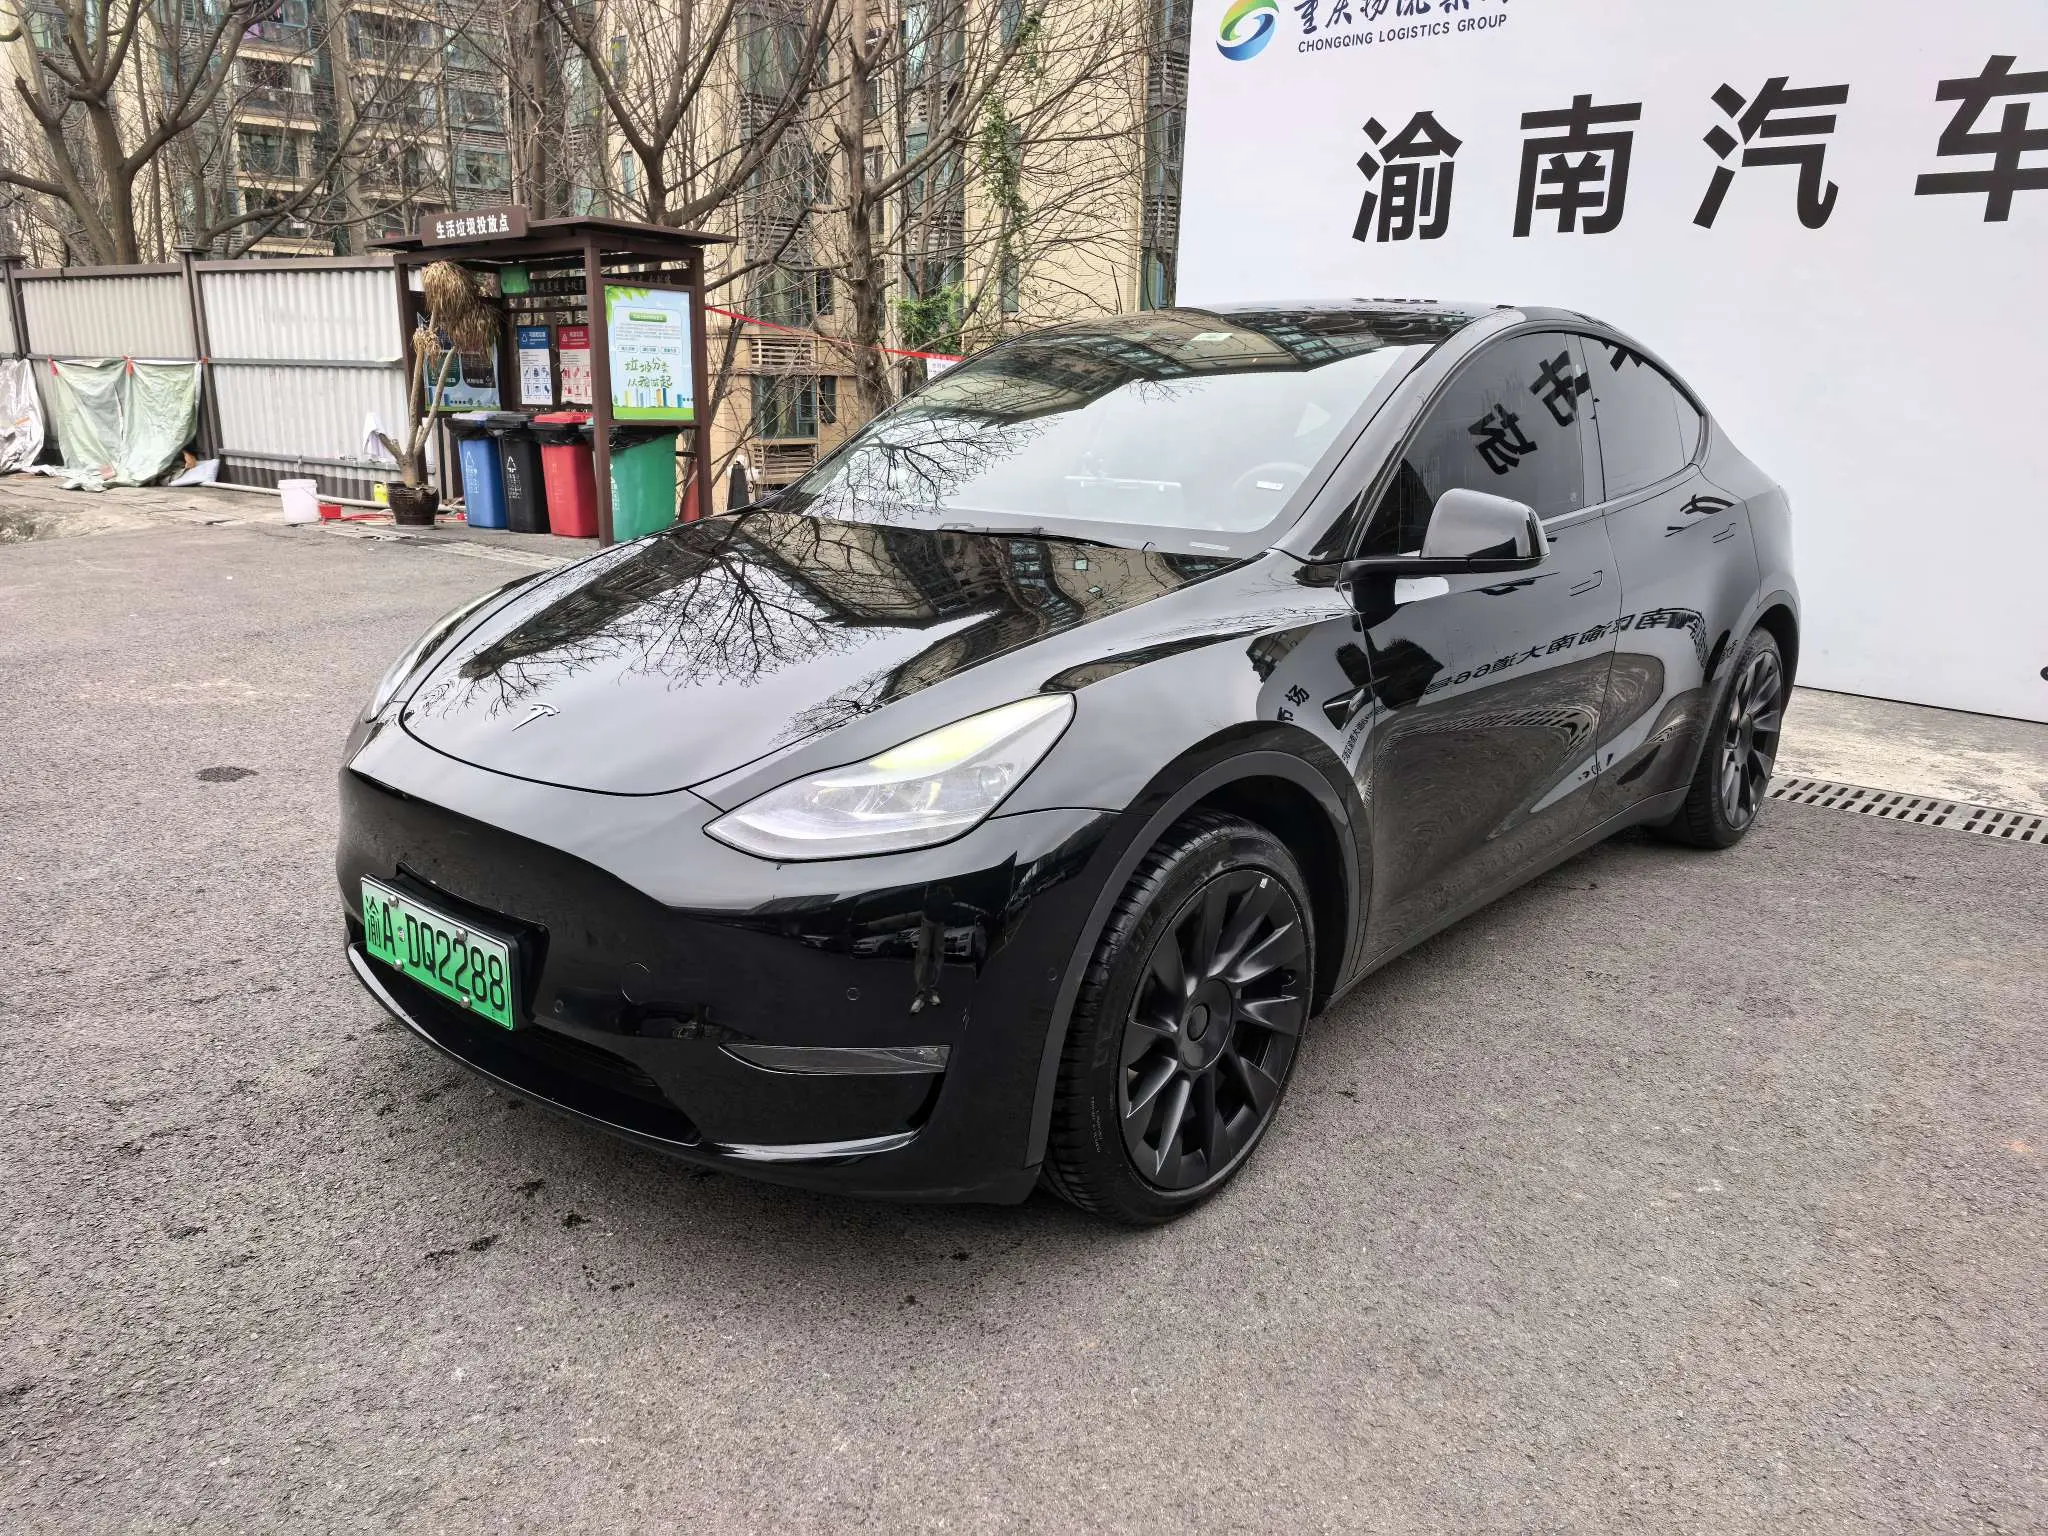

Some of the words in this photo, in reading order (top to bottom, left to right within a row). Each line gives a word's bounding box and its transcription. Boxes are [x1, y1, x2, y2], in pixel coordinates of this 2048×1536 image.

[1298, 32, 1374, 53] CHONGQING
[1379, 21, 1450, 43] LOGISTICS
[1457, 13, 1507, 32] GROUP
[1352, 54, 2048, 243] 渝南汽车
[435, 213, 510, 239] 生活垃圾投放点
